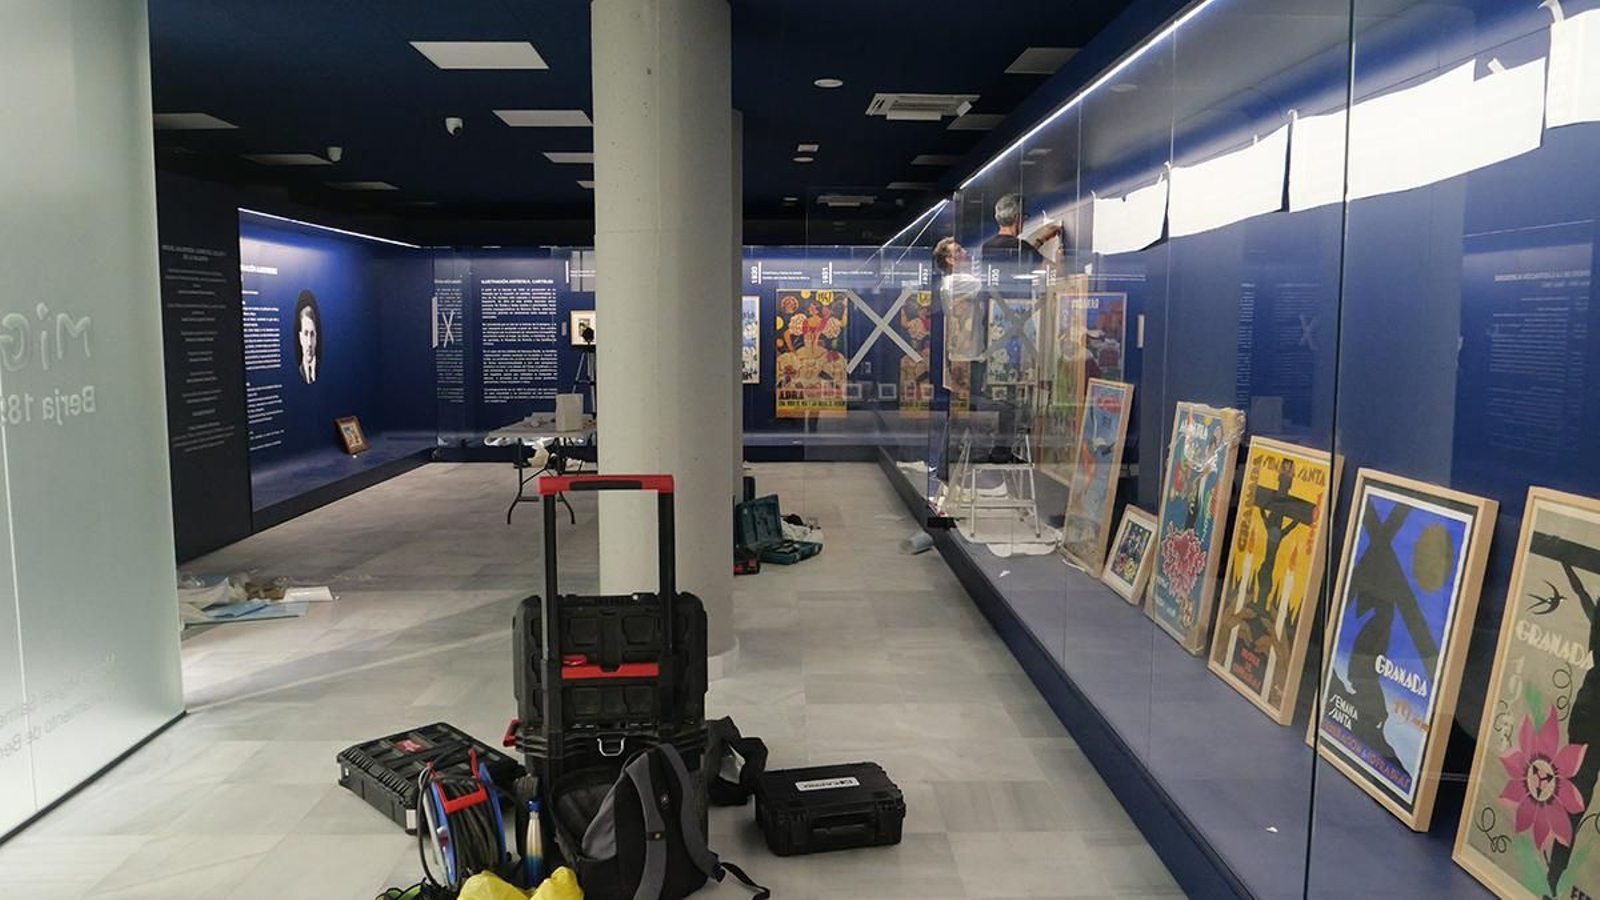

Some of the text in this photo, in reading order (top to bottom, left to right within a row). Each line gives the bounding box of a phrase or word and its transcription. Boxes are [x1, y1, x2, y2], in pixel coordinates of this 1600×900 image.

[1515, 619, 1595, 671] GRANADA
[1374, 654, 1428, 698] GRANADA
[1328, 707, 1352, 731] SANTA
[1329, 694, 1358, 721] SEMANA
